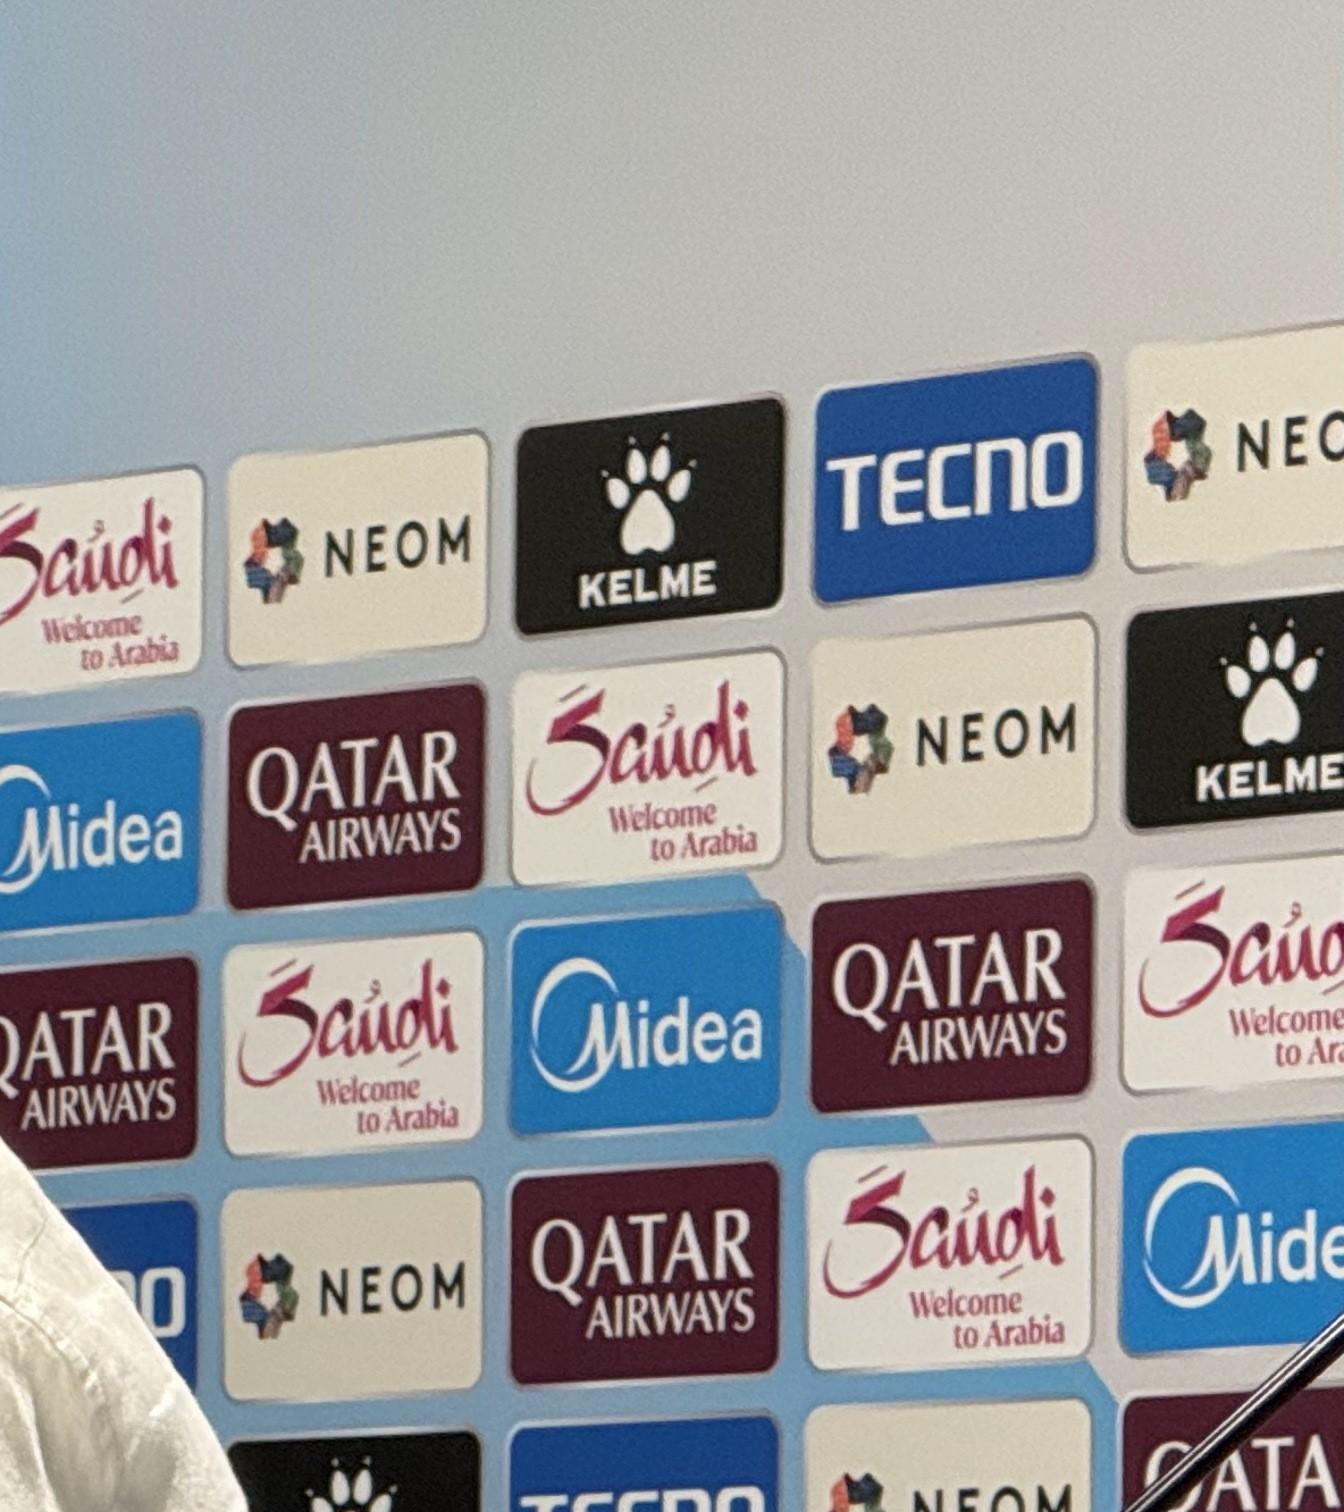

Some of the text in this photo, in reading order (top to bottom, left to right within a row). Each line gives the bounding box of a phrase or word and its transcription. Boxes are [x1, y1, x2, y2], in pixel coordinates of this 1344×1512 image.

[1237, 410, 1344, 473] NEO
[826, 431, 1085, 532] TECNO
[325, 514, 472, 579] NEOM
[579, 560, 718, 609] KELME
[42, 611, 142, 646] Welcome
[81, 635, 180, 671] to Arabia
[916, 703, 1077, 768] NEOM
[246, 730, 462, 828] QATAR
[1196, 752, 1344, 802] KELME
[298, 807, 462, 865] AIRWAYS
[608, 802, 718, 836] Welcome
[649, 826, 759, 862] to Arabia
[832, 926, 1065, 1033] QATAR
[531, 997, 764, 1094] Midea
[889, 1009, 1069, 1067] AIRWAYS
[1275, 1042, 1302, 1067] to
[20, 1078, 177, 1131] AIRWAYS
[317, 1076, 421, 1107] Welcome
[357, 1103, 459, 1134] to Arabia
[531, 1207, 755, 1307] QATAR
[1143, 1207, 1344, 1309] Mide
[319, 1262, 467, 1317] NEOM
[586, 1288, 756, 1342] AIRWAYS
[909, 1288, 1023, 1319] Welcome
[953, 1316, 1066, 1349] to Arabia
